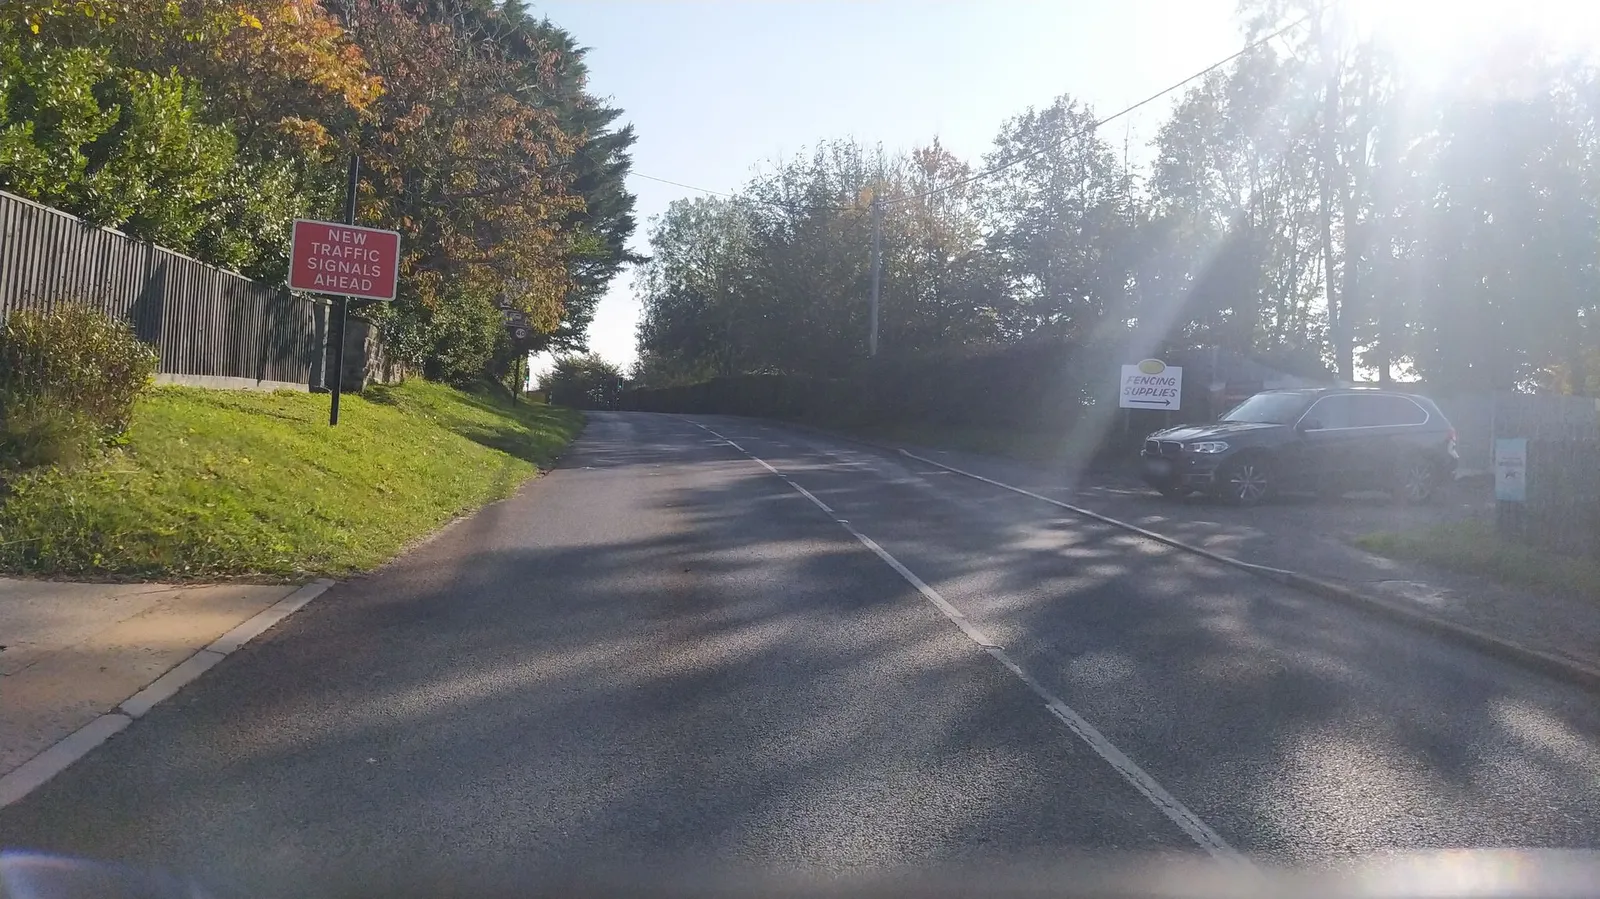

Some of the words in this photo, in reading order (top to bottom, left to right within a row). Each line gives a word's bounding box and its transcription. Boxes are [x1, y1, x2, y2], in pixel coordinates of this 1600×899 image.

[328, 229, 367, 245] NEW
[311, 242, 380, 262] TRAFFIC
[307, 257, 381, 278] SIGNALS
[313, 273, 372, 291] AHEAD
[1126, 375, 1176, 387] FENCING
[1123, 386, 1178, 398] SUPPLIES
